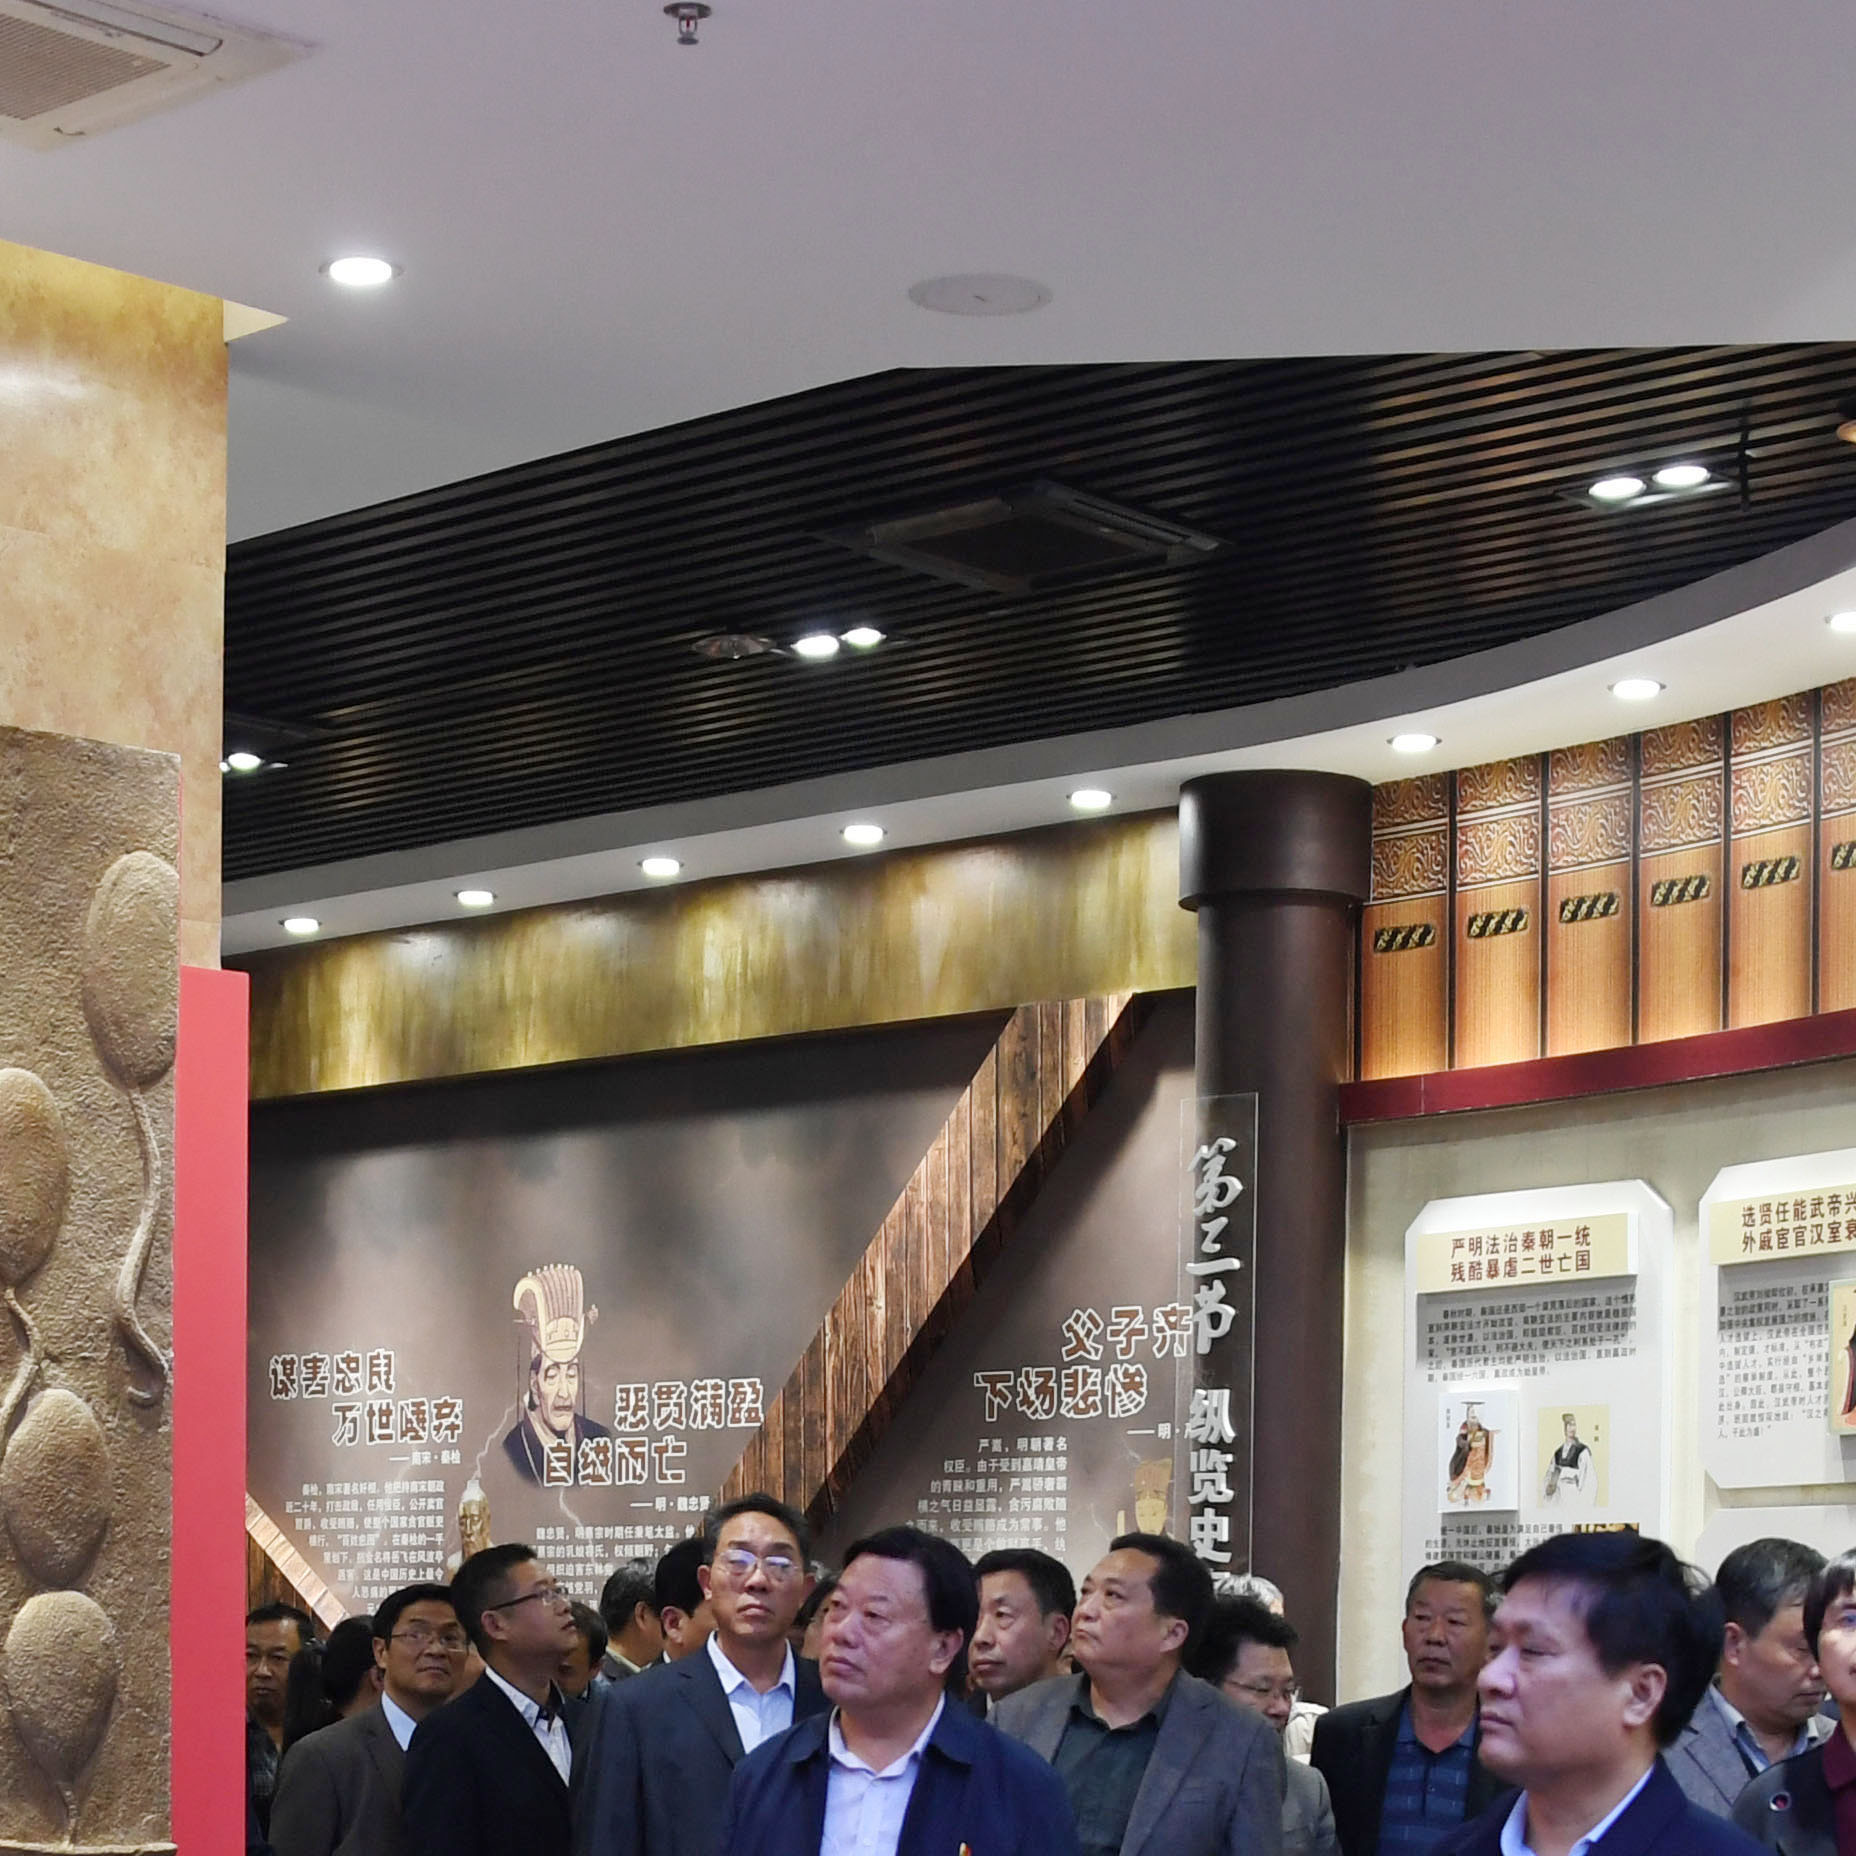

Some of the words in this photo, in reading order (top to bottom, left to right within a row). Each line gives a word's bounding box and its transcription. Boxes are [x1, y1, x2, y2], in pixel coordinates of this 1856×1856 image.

[1187, 1137, 1244, 1356] 第三节
[1450, 1249, 1591, 1283] 残酷暴虐二世亡国
[1451, 1225, 1591, 1259] 严明法治秦朝一统
[269, 1348, 396, 1399] 谋害忠良
[974, 1363, 1147, 1422] 下场悲惨
[332, 1396, 464, 1446] 万世唾弃
[614, 1378, 765, 1432] 恶贯满盈
[544, 1435, 687, 1487] 自缢而亡
[1188, 1388, 1236, 1590] 纵览史
